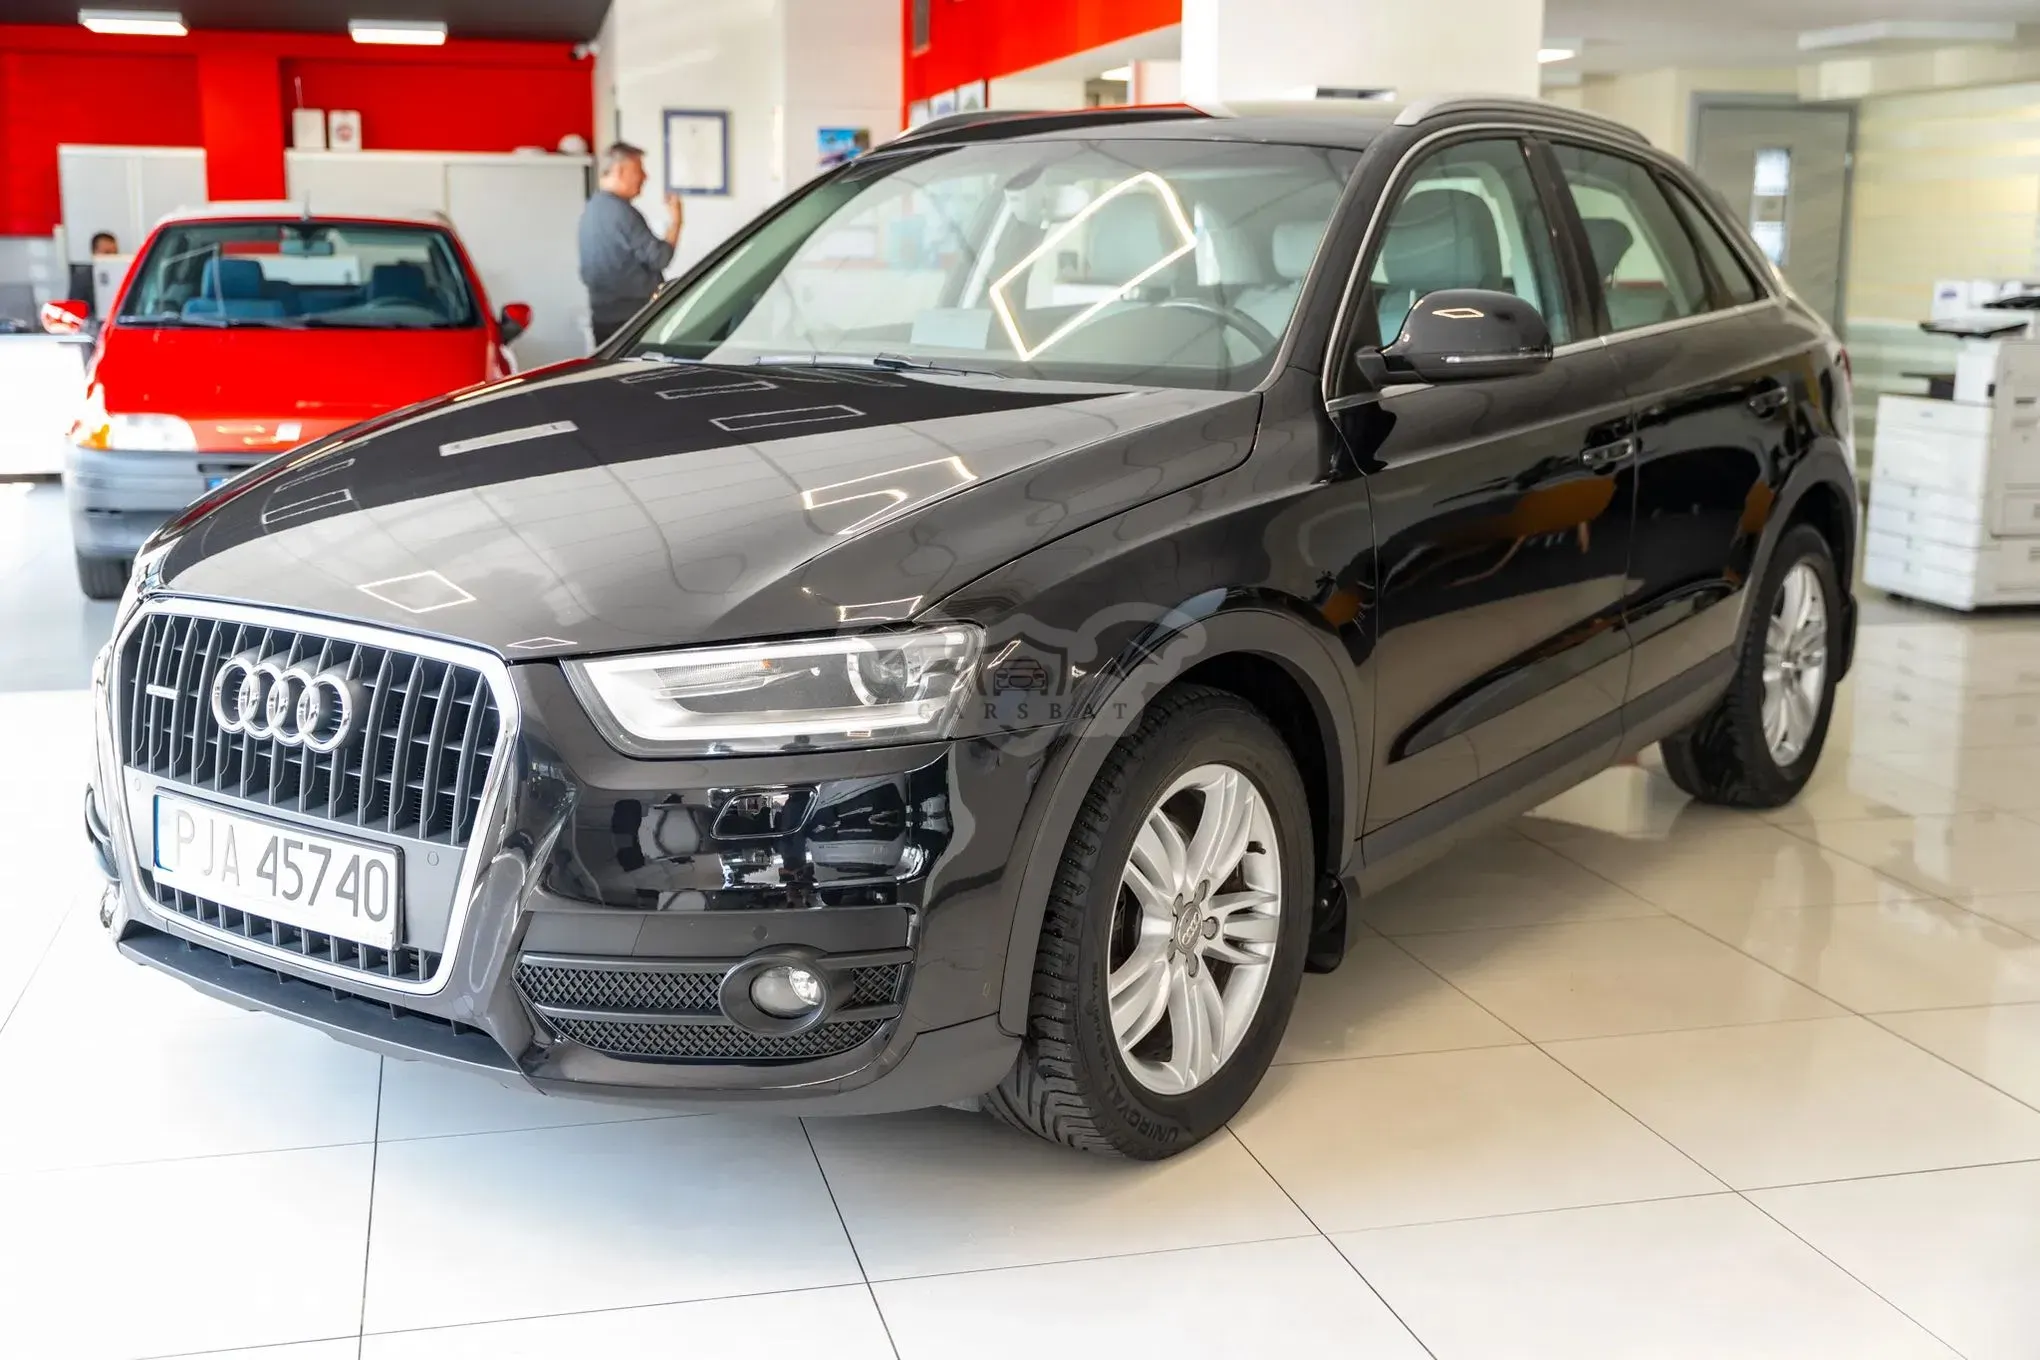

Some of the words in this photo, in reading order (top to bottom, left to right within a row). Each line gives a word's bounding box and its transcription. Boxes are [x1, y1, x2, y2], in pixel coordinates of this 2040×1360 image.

[175, 808, 241, 887] PJA
[255, 835, 389, 923] 45740
[1106, 1073, 1180, 1145] UNIROYAL
